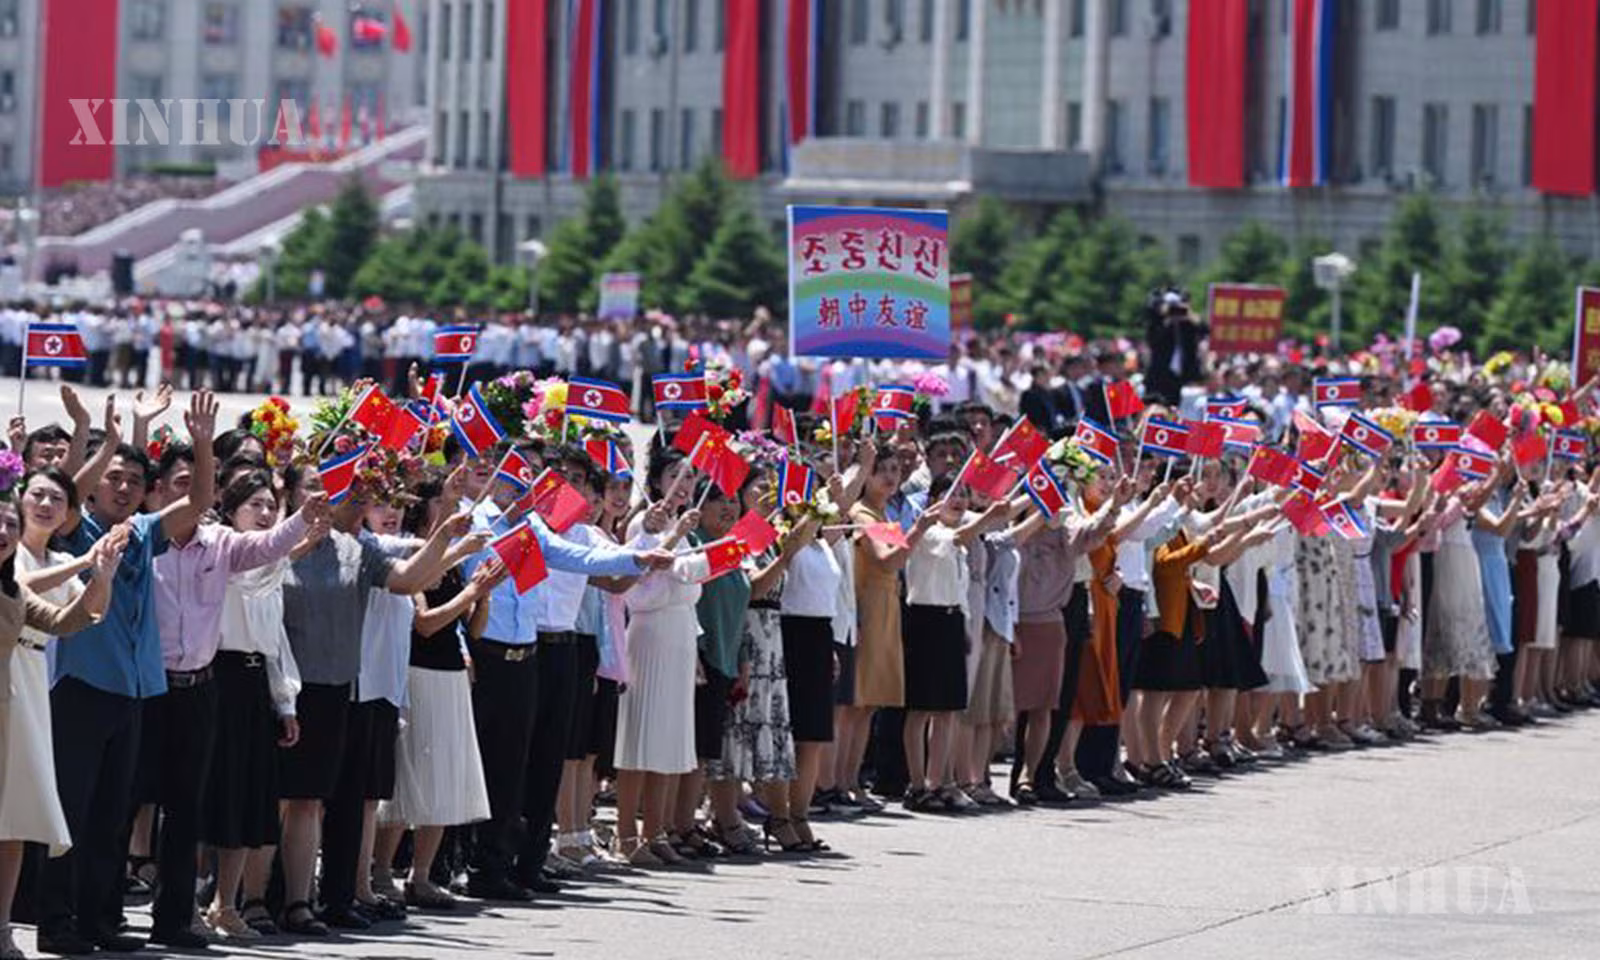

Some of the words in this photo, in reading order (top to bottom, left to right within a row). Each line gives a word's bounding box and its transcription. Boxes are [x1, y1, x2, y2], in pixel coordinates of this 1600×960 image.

[803, 229, 940, 279] 조중친선
[818, 291, 929, 330] 朝中友谊
